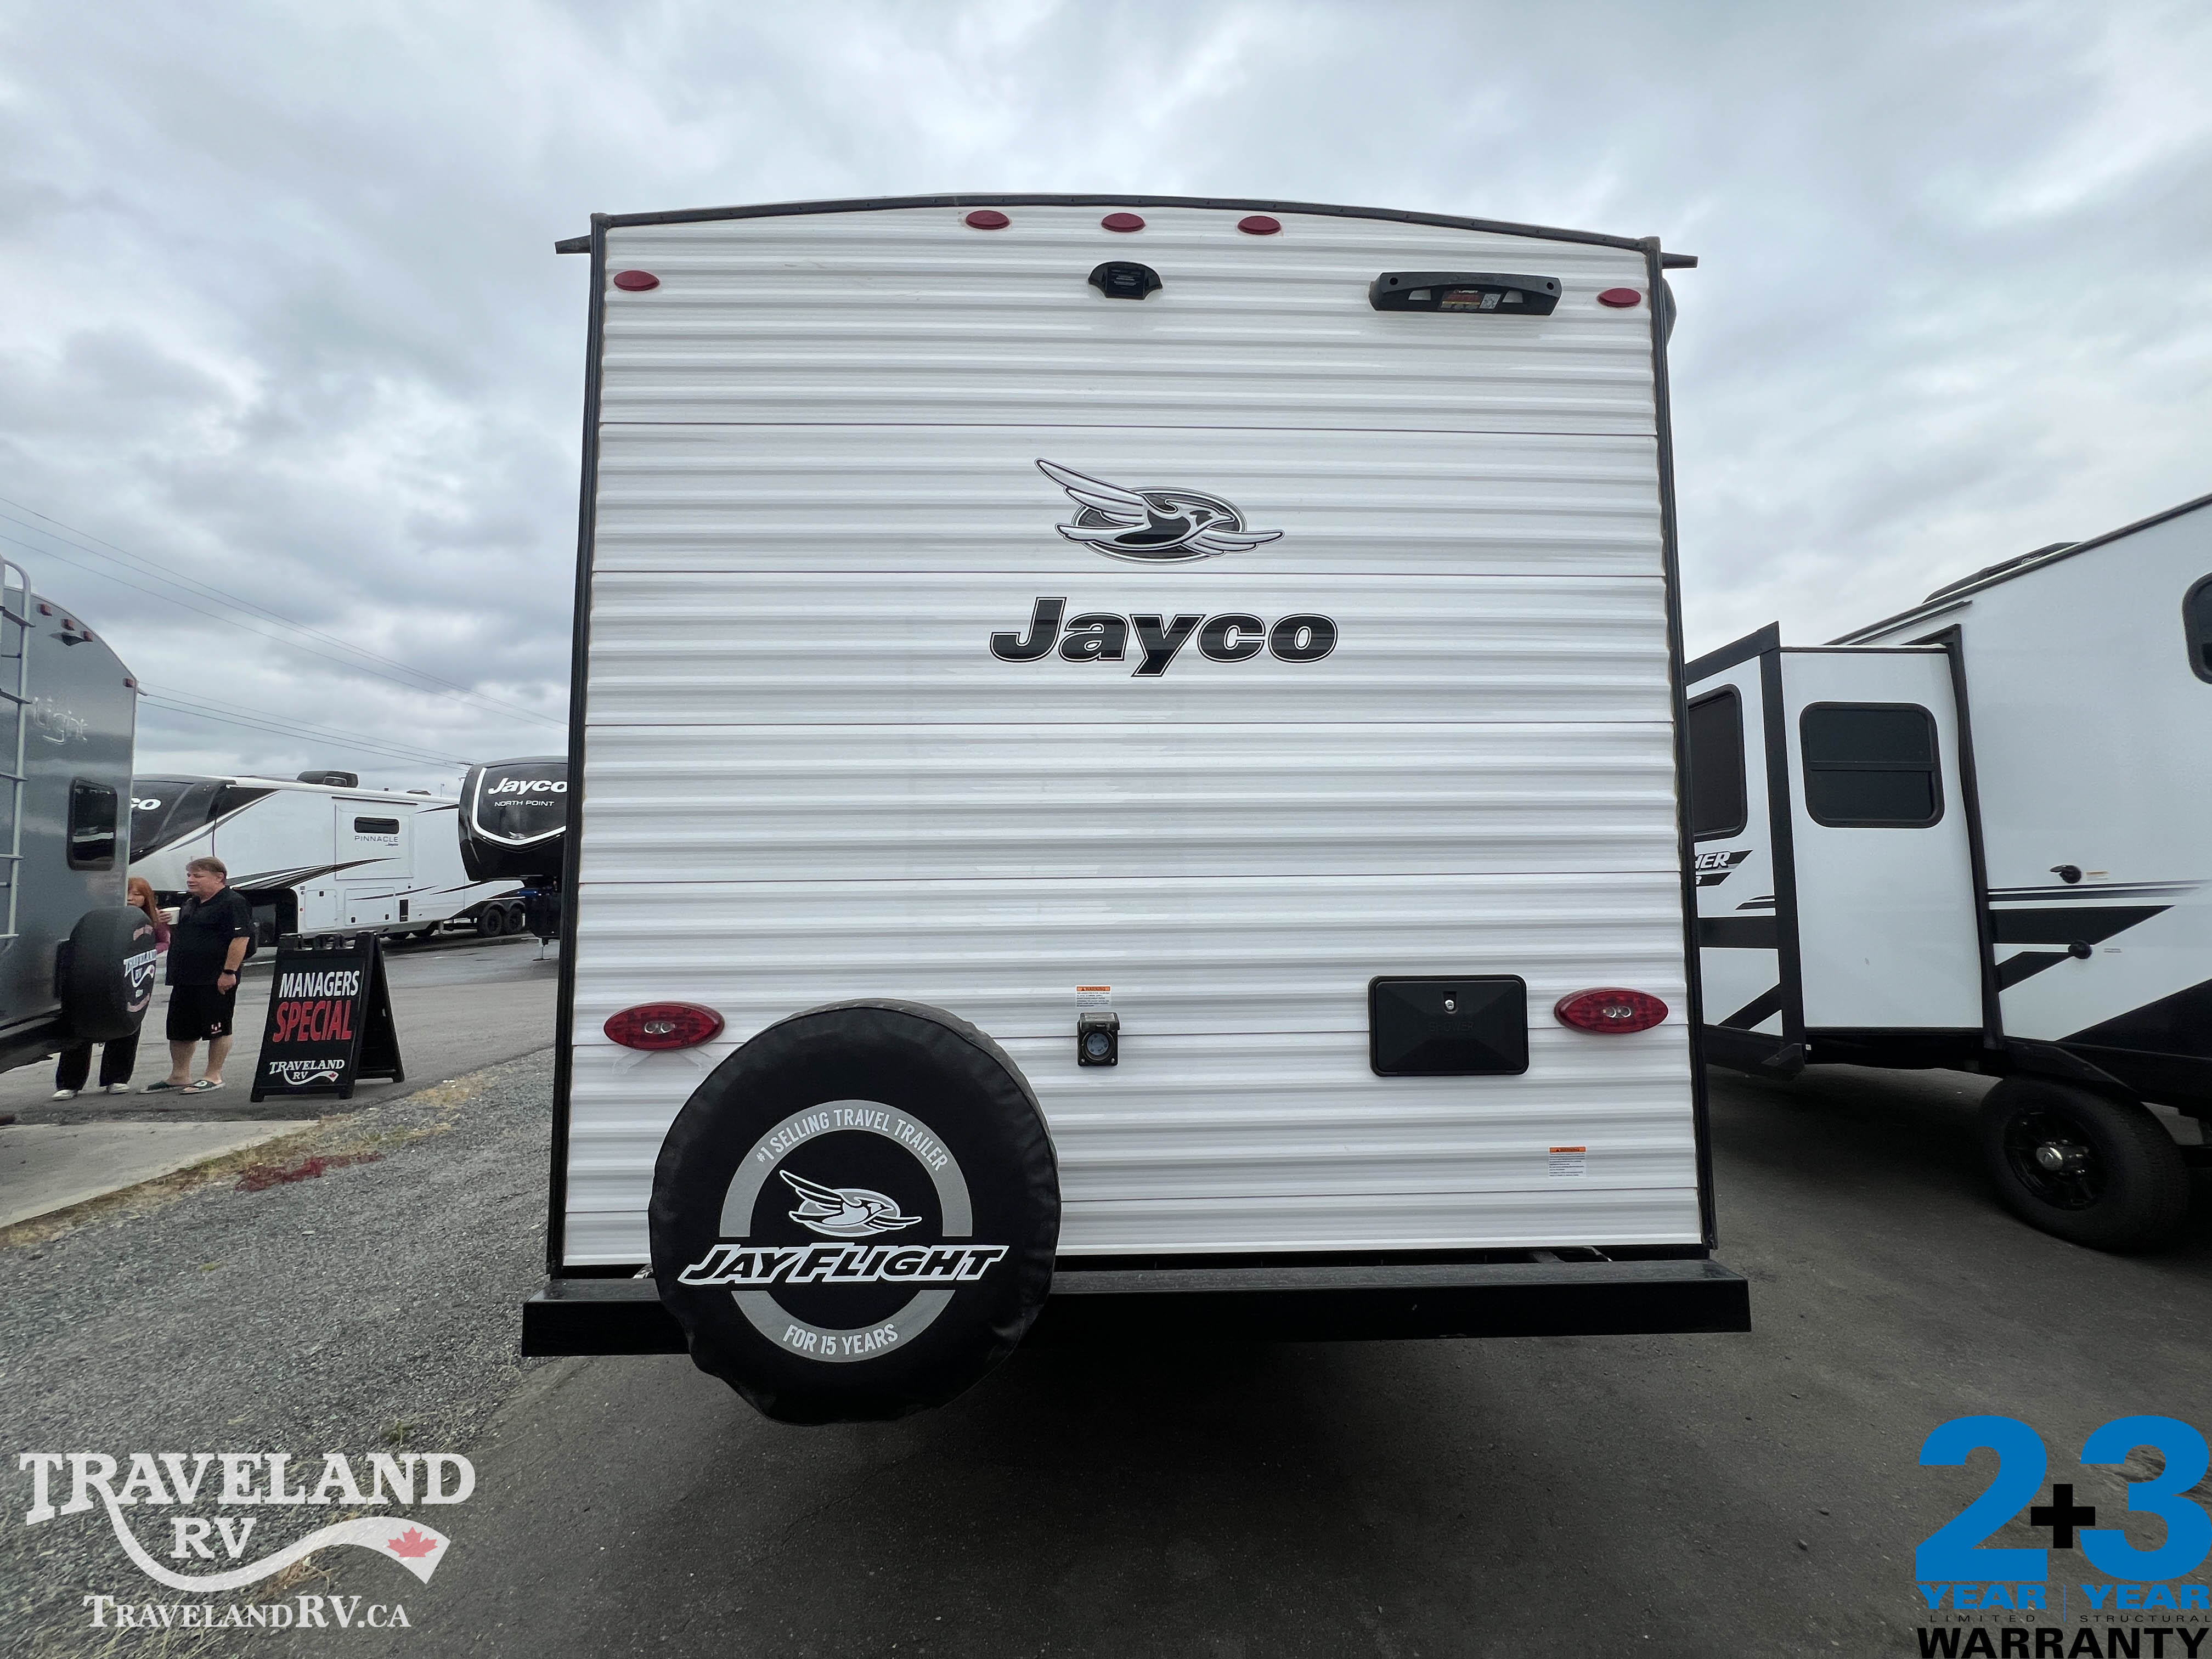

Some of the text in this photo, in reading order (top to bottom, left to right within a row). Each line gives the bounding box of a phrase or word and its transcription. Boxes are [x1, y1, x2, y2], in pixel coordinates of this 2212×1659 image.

[990, 596, 1338, 678] Jayco
[488, 777, 568, 795] Jayco
[279, 970, 360, 998] MANAGERS
[273, 1000, 352, 1042] SPECIAL
[269, 1059, 345, 1075] TRAVELAND
[292, 1071, 308, 1080] RV
[756, 1109, 948, 1171] #1 SELLING TRAVEL TRAILER
[782, 1323, 898, 1355] FOR 15 YEARS
